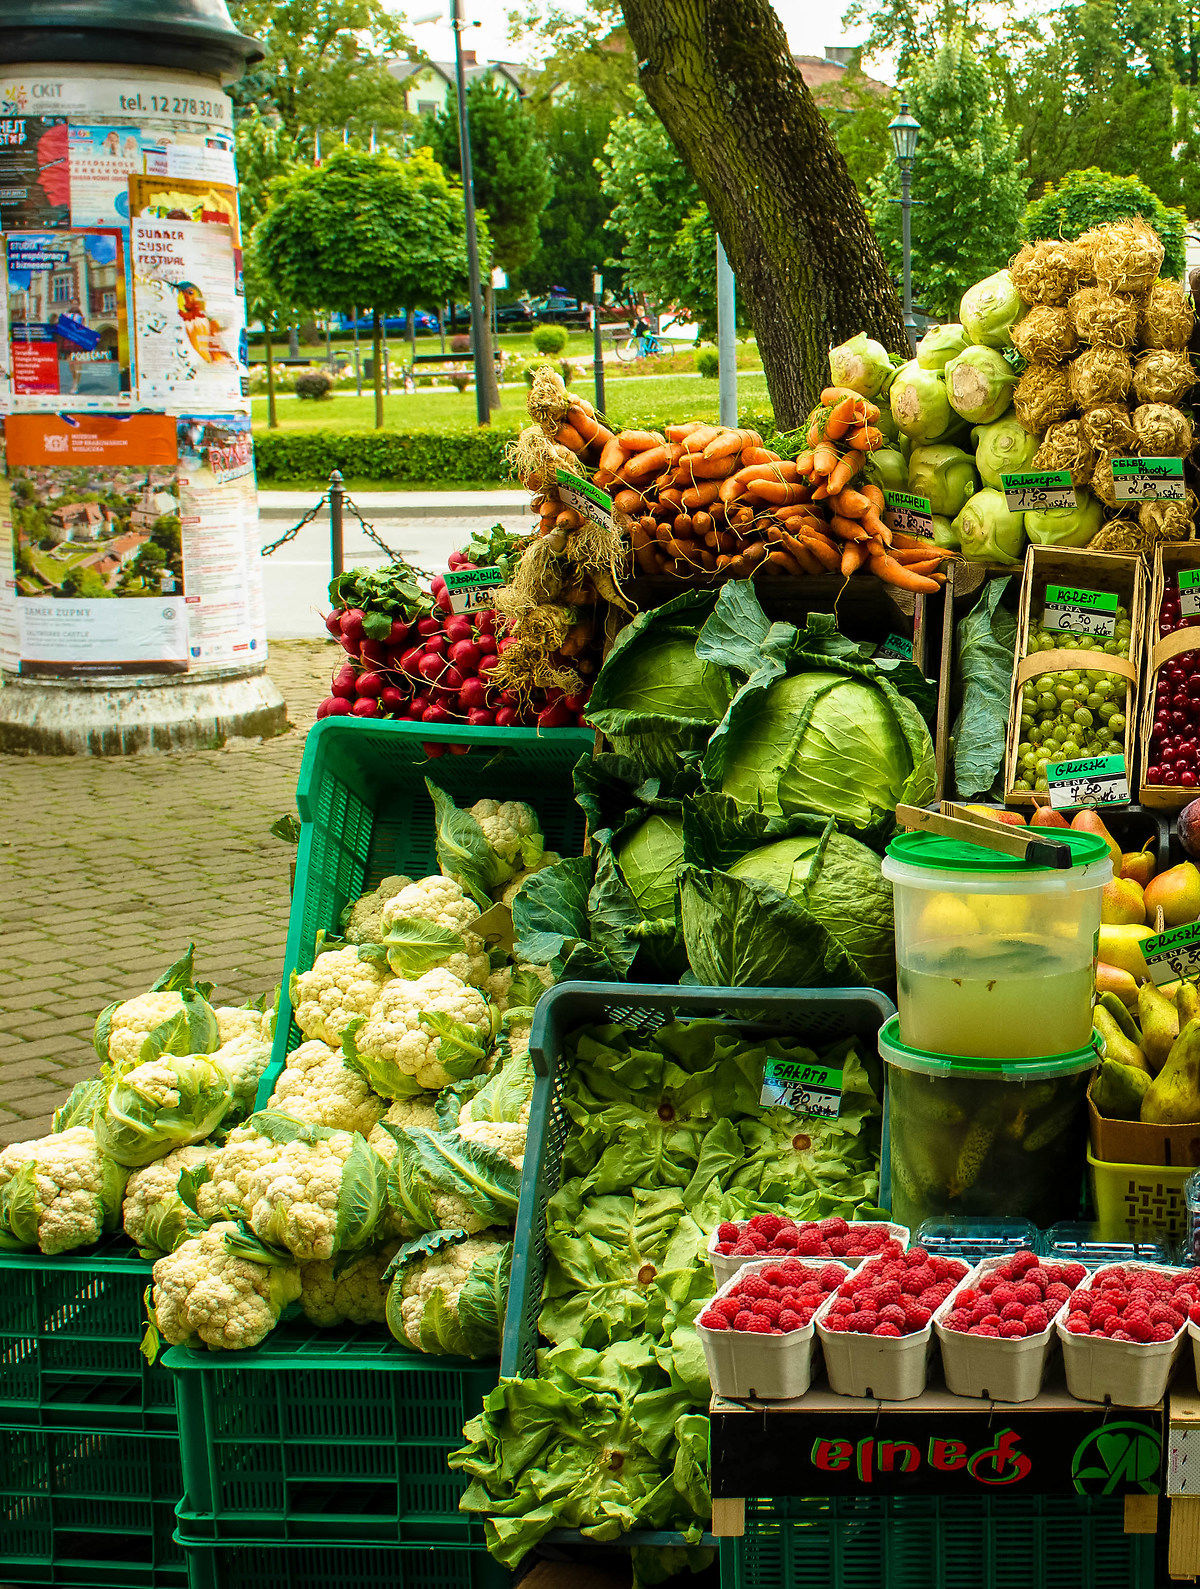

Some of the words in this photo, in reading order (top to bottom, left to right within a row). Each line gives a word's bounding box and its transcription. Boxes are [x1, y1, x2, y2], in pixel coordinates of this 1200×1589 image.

[31, 83, 64, 98] CKiT
[119, 93, 147, 111] tel.
[151, 95, 169, 113] 12
[172, 97, 197, 115] 278
[199, 100, 213, 118] 32
[1056, 589, 1102, 605] AGREST
[1049, 603, 1082, 614] CENA
[1054, 778, 1090, 788] CENA
[1150, 947, 1188, 965] CENA
[772, 1062, 828, 1084] SAŁATA
[809, 1426, 1032, 1486] Paula
